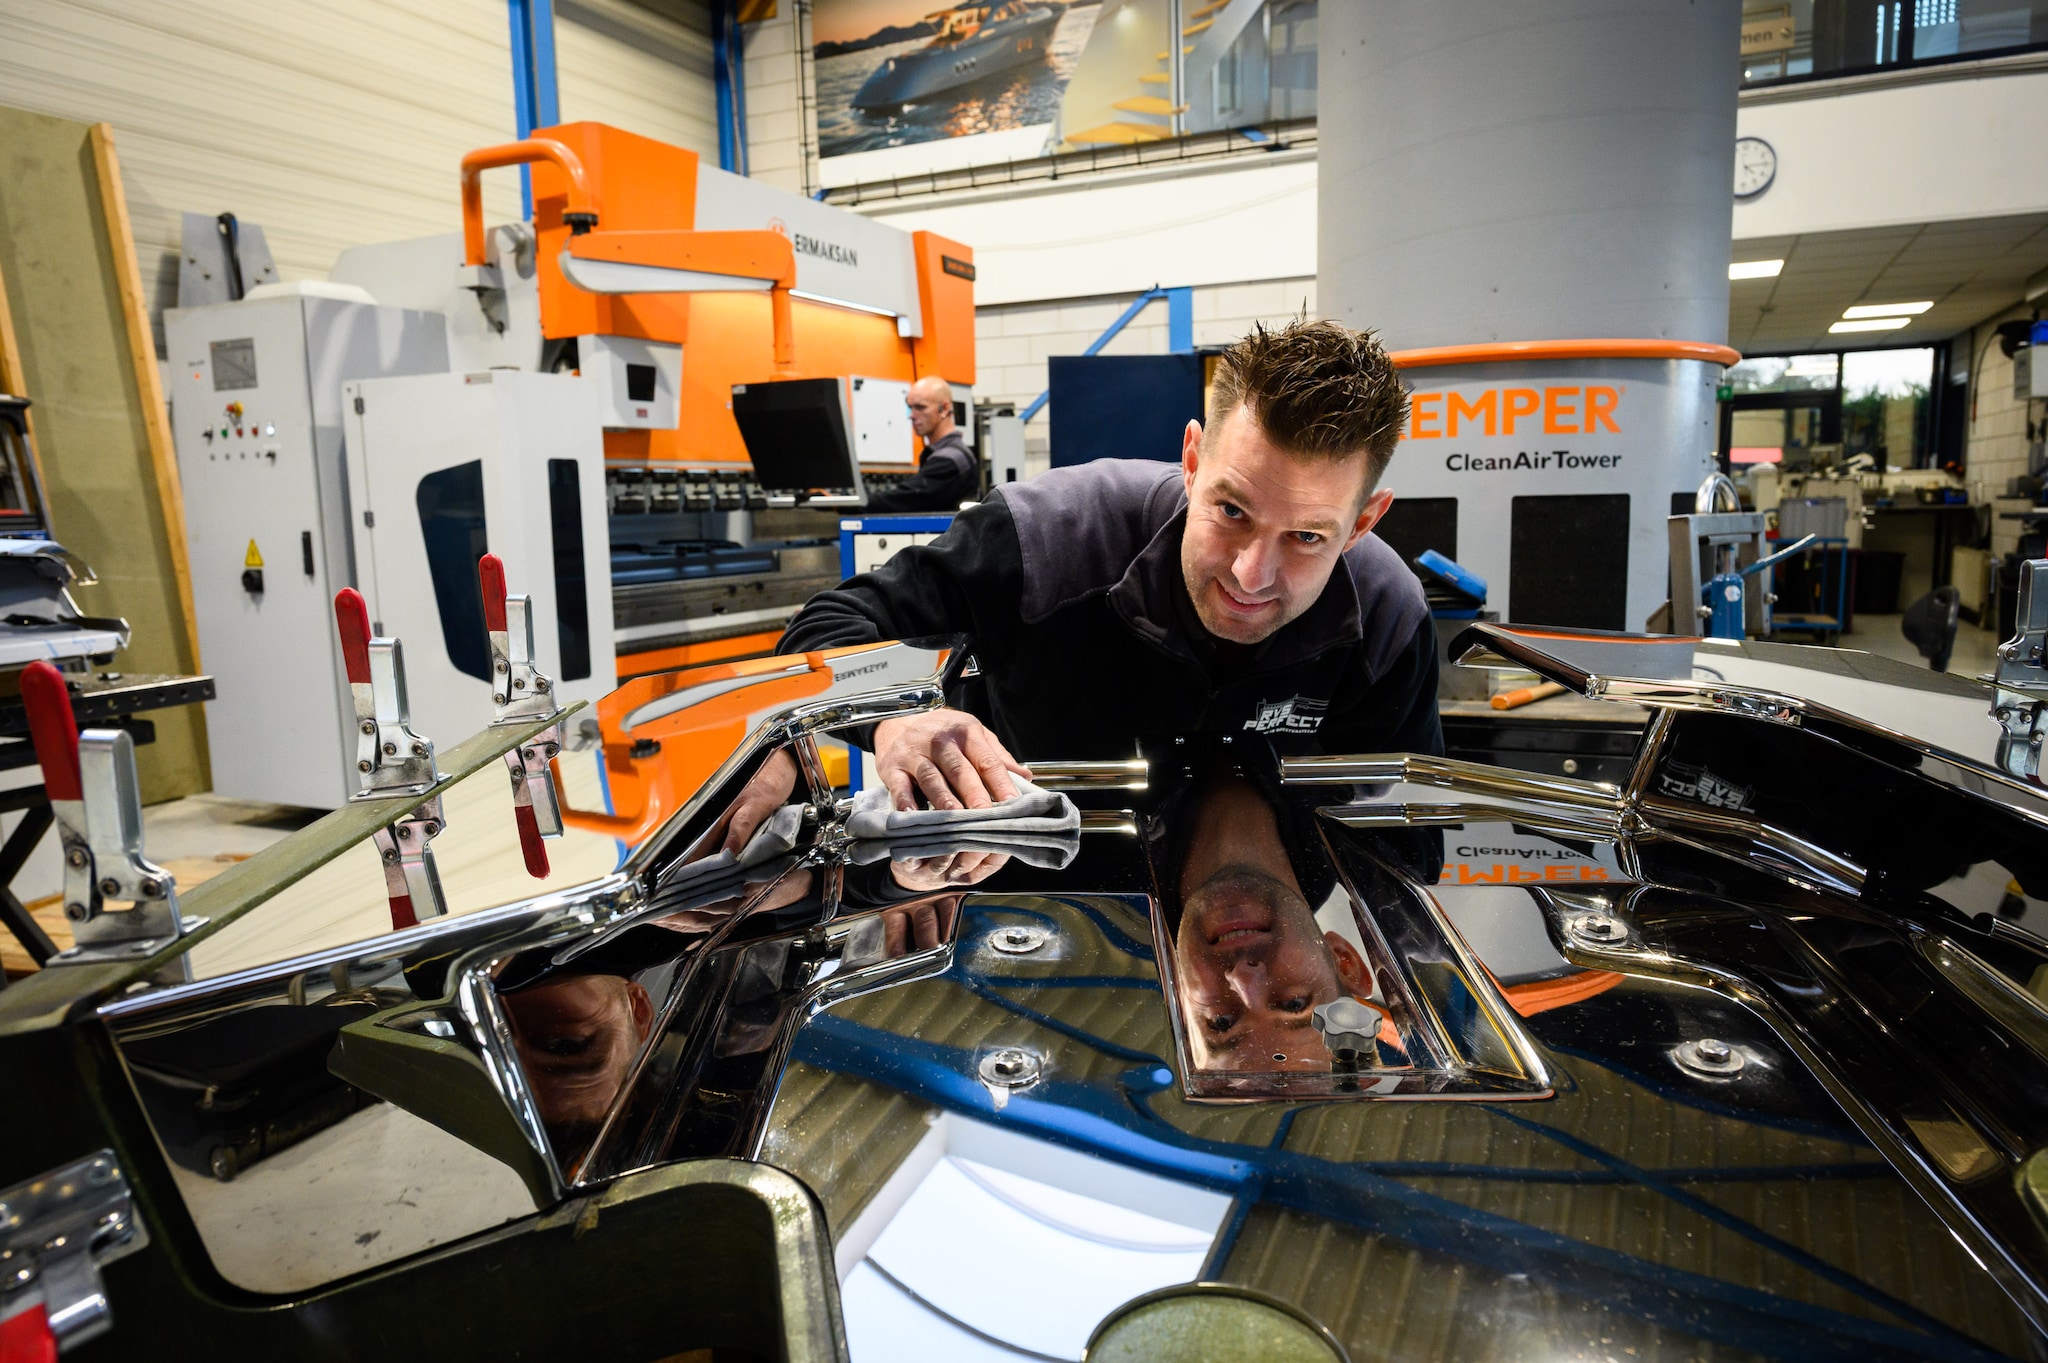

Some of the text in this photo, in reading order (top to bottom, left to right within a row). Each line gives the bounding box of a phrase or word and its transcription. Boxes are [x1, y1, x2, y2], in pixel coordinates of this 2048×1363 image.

[795, 234, 858, 268] ERMAKSAN
[1398, 386, 1622, 440] EMPER
[1242, 714, 1324, 731] PERFECT
[1260, 703, 1293, 720] RVS
